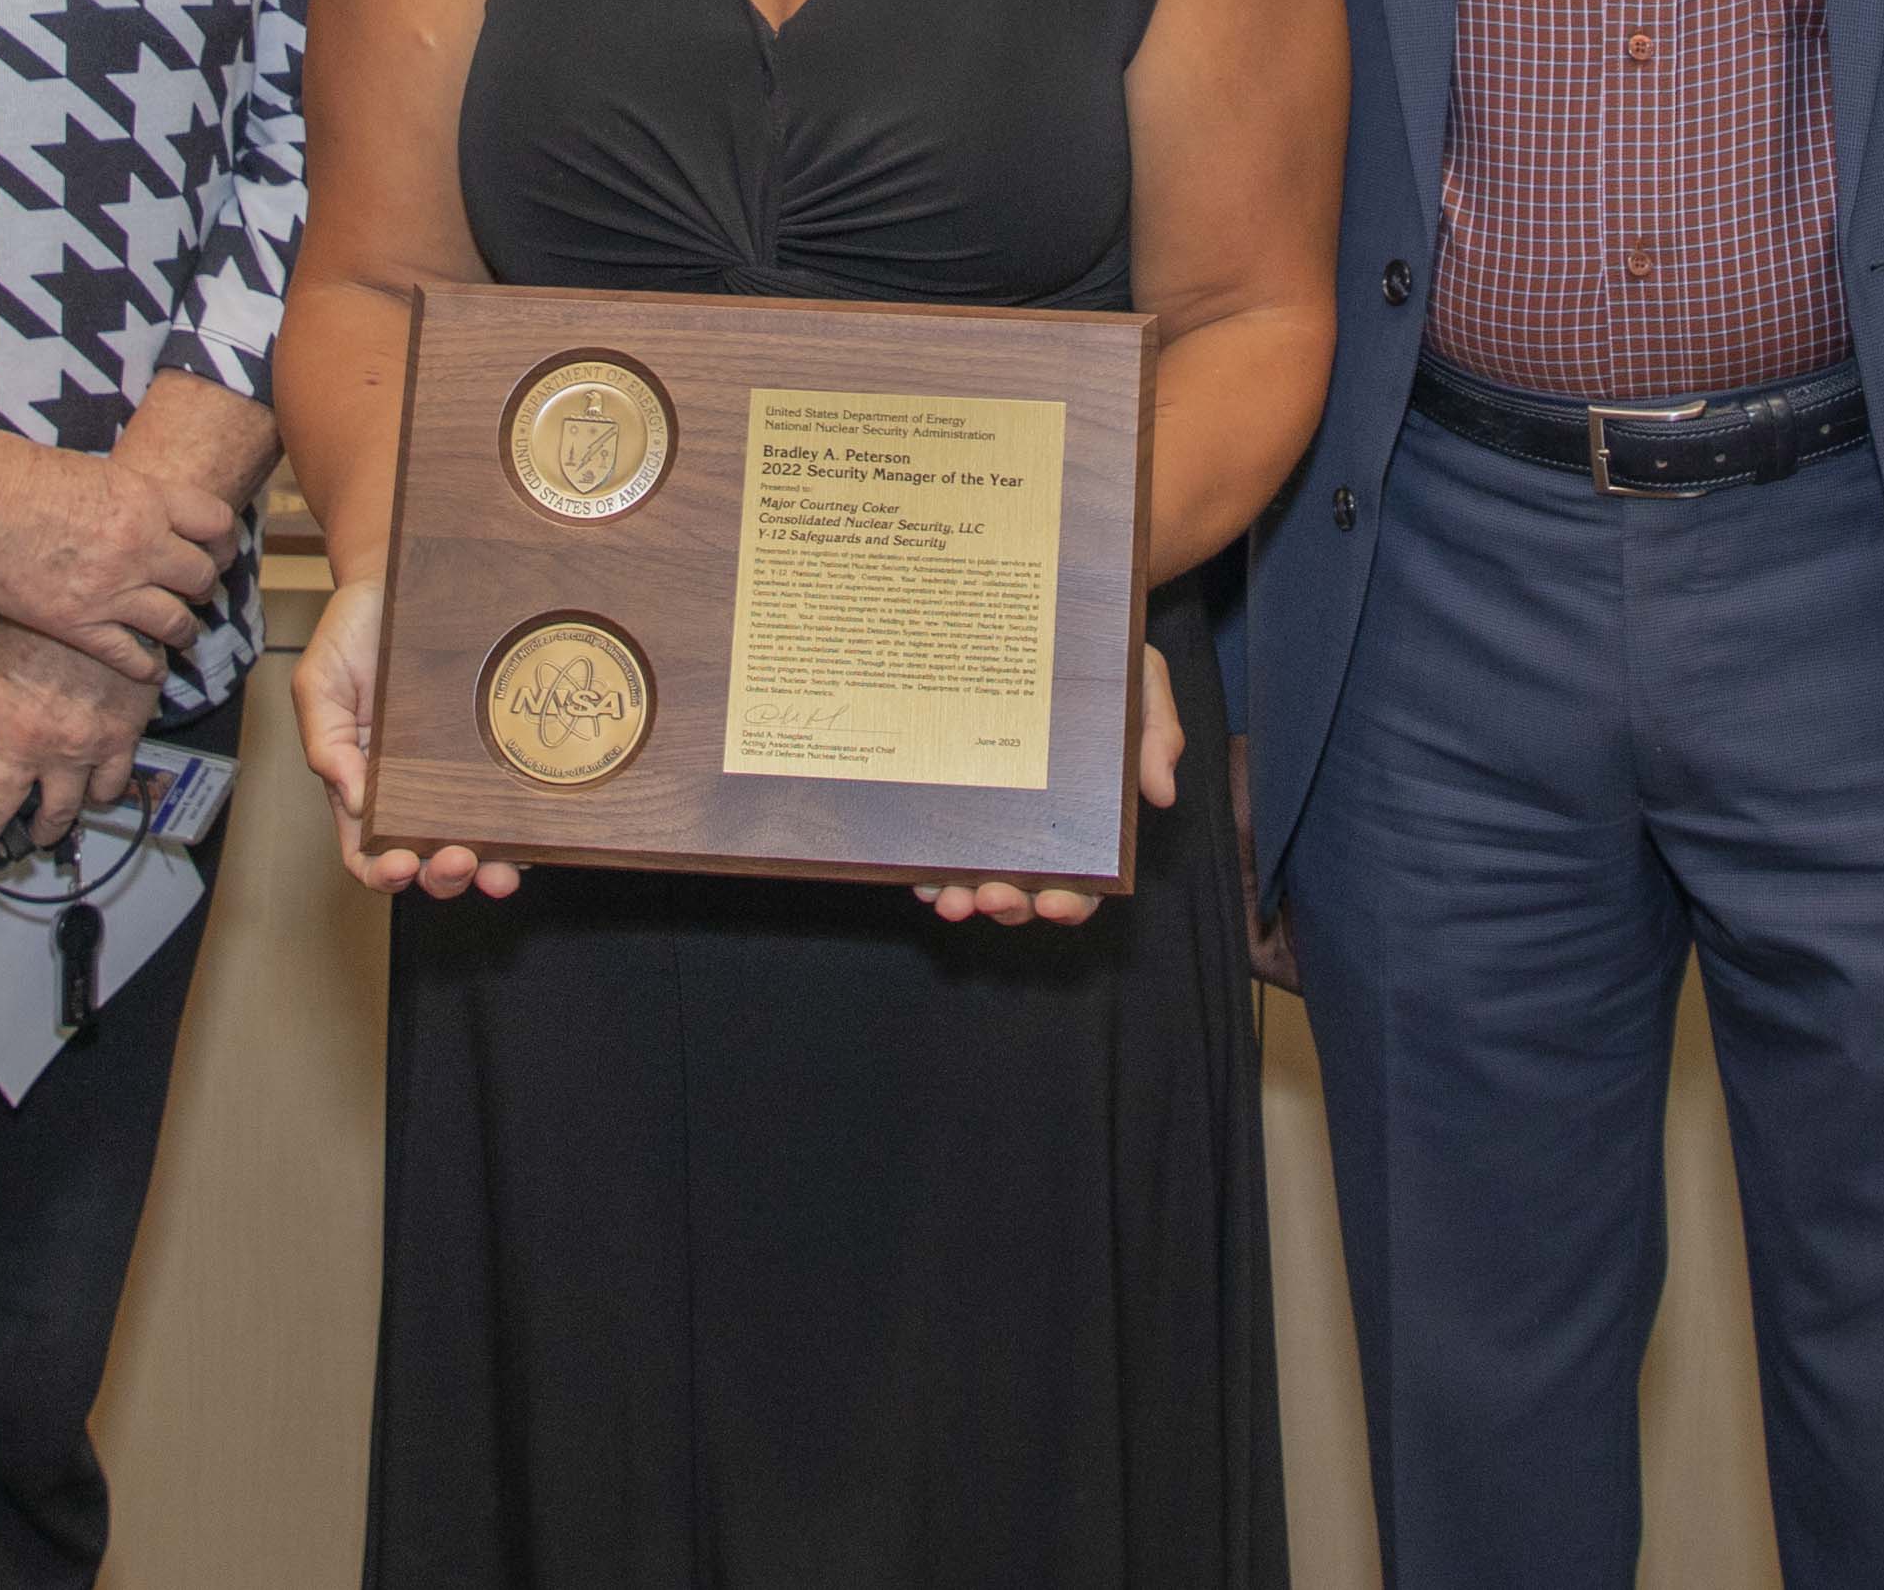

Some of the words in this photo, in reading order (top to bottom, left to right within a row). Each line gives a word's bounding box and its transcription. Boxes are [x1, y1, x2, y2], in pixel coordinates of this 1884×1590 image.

[518, 367, 603, 426] DEPARTMENT
[607, 369, 627, 383] OF
[627, 380, 665, 437] ENERGY
[764, 418, 812, 431] National
[815, 421, 859, 434] Nuclear
[862, 423, 908, 438] Security
[912, 427, 995, 441] Administration
[762, 444, 818, 462] Bradley
[822, 447, 839, 460] A.
[845, 448, 910, 464] Peterson
[514, 438, 542, 490] UNITED
[540, 487, 592, 515] STATES
[596, 497, 617, 514] OF
[619, 449, 665, 506] AMERICA
[761, 461, 801, 476] 2022
[806, 463, 868, 482] Security
[872, 467, 936, 486] Manager
[940, 470, 956, 484] of
[960, 471, 984, 485] the
[989, 472, 1024, 487] Year
[759, 496, 796, 510] Major
[799, 497, 858, 514] Courtney
[861, 501, 900, 513] Coker
[758, 511, 841, 527] Consolidated
[844, 516, 894, 529] Nuclear
[958, 521, 985, 534] LLC
[758, 527, 786, 540] Y-12
[788, 529, 861, 544] Safeguards
[864, 534, 889, 545] and
[892, 534, 946, 551] Security
[974, 736, 996, 746] June
[997, 737, 1021, 747] 2023
[838, 752, 869, 763] Security
